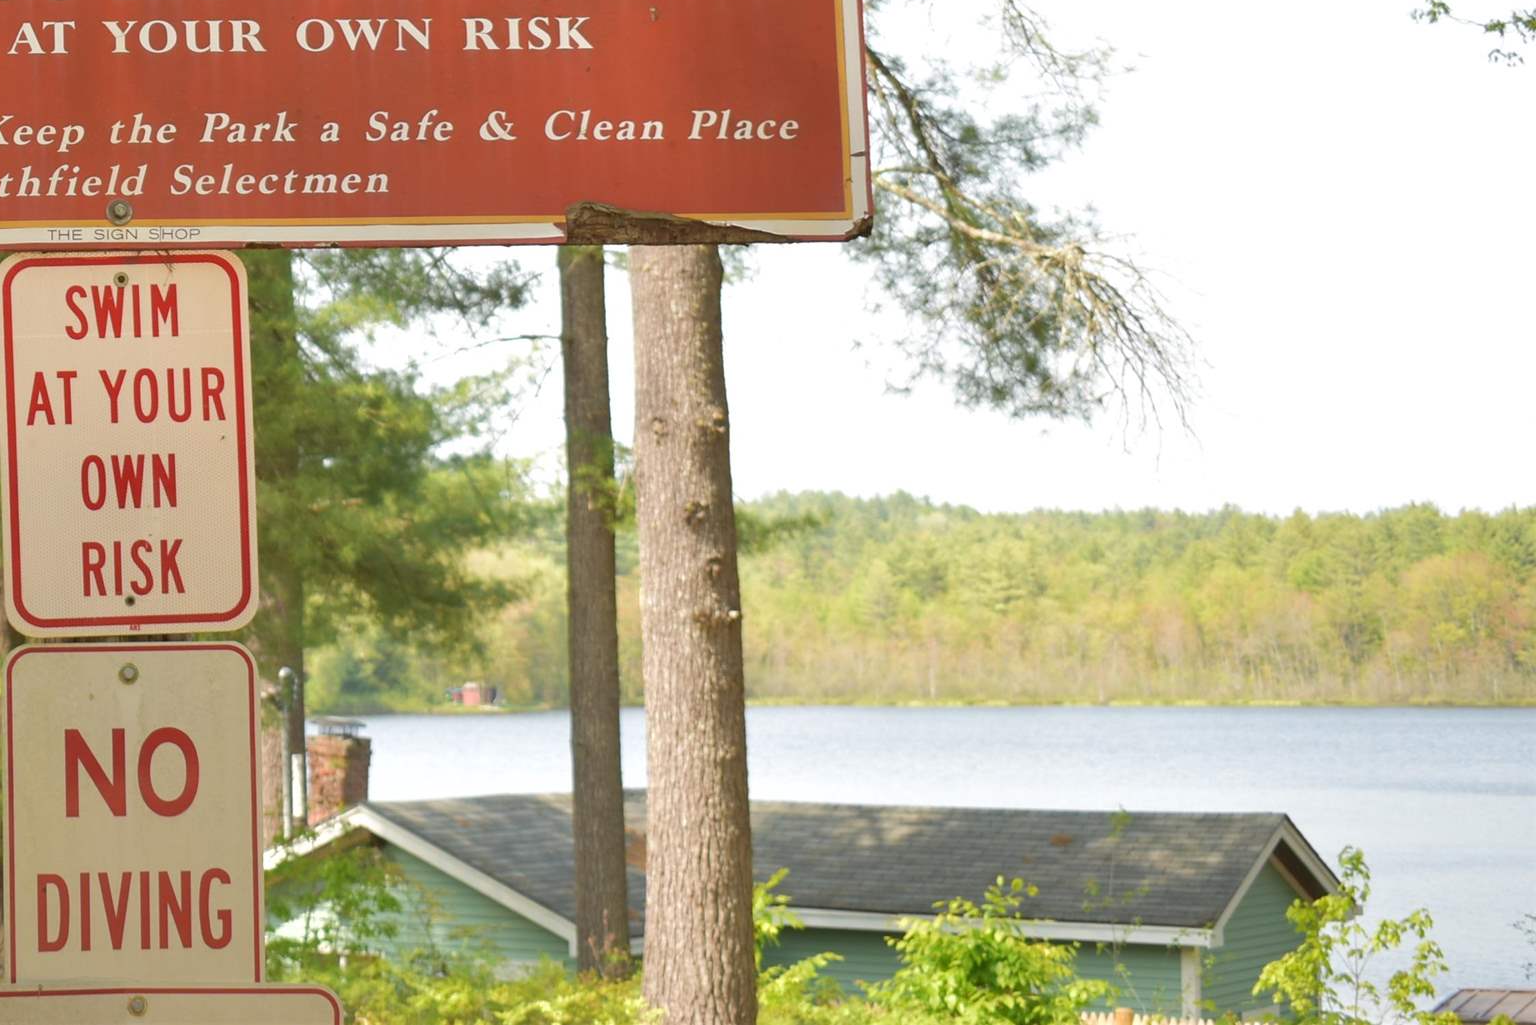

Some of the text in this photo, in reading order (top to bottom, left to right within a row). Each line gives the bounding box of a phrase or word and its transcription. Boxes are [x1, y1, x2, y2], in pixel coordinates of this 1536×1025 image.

[8, 20, 76, 55] AT
[104, 19, 266, 54] YOUR
[295, 18, 431, 52] OWN
[463, 16, 593, 51] RISK
[110, 112, 177, 144] the
[201, 111, 298, 143] Park
[320, 122, 340, 143] a
[365, 109, 454, 142] Safe
[479, 110, 517, 141] &
[544, 109, 664, 141] Clean
[688, 109, 799, 140] Place
[170, 163, 389, 195] Selectmen
[47, 227, 201, 242] THE SIGN SHOP
[64, 282, 180, 341] SWIM
[26, 366, 227, 427] AT YOUR
[81, 453, 177, 512] OWN
[82, 538, 186, 598] RISK
[64, 726, 200, 818] NO
[37, 867, 233, 952] DIVING
